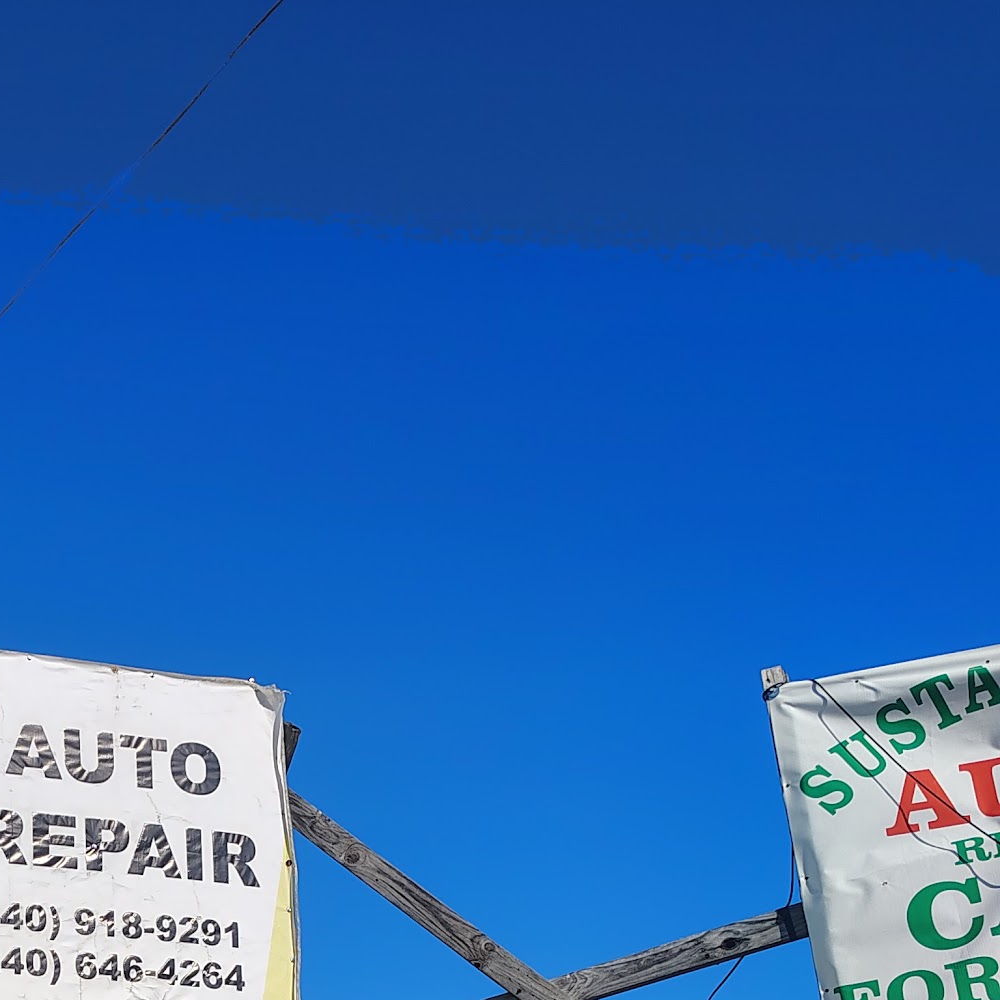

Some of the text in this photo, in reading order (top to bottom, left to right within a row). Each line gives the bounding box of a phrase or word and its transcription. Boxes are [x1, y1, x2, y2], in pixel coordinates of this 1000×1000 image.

[5, 723, 221, 795] AUTO
[73, 907, 239, 948] 918-9291
[907, 877, 1000, 950] C
[75, 952, 245, 991] 646-4264
